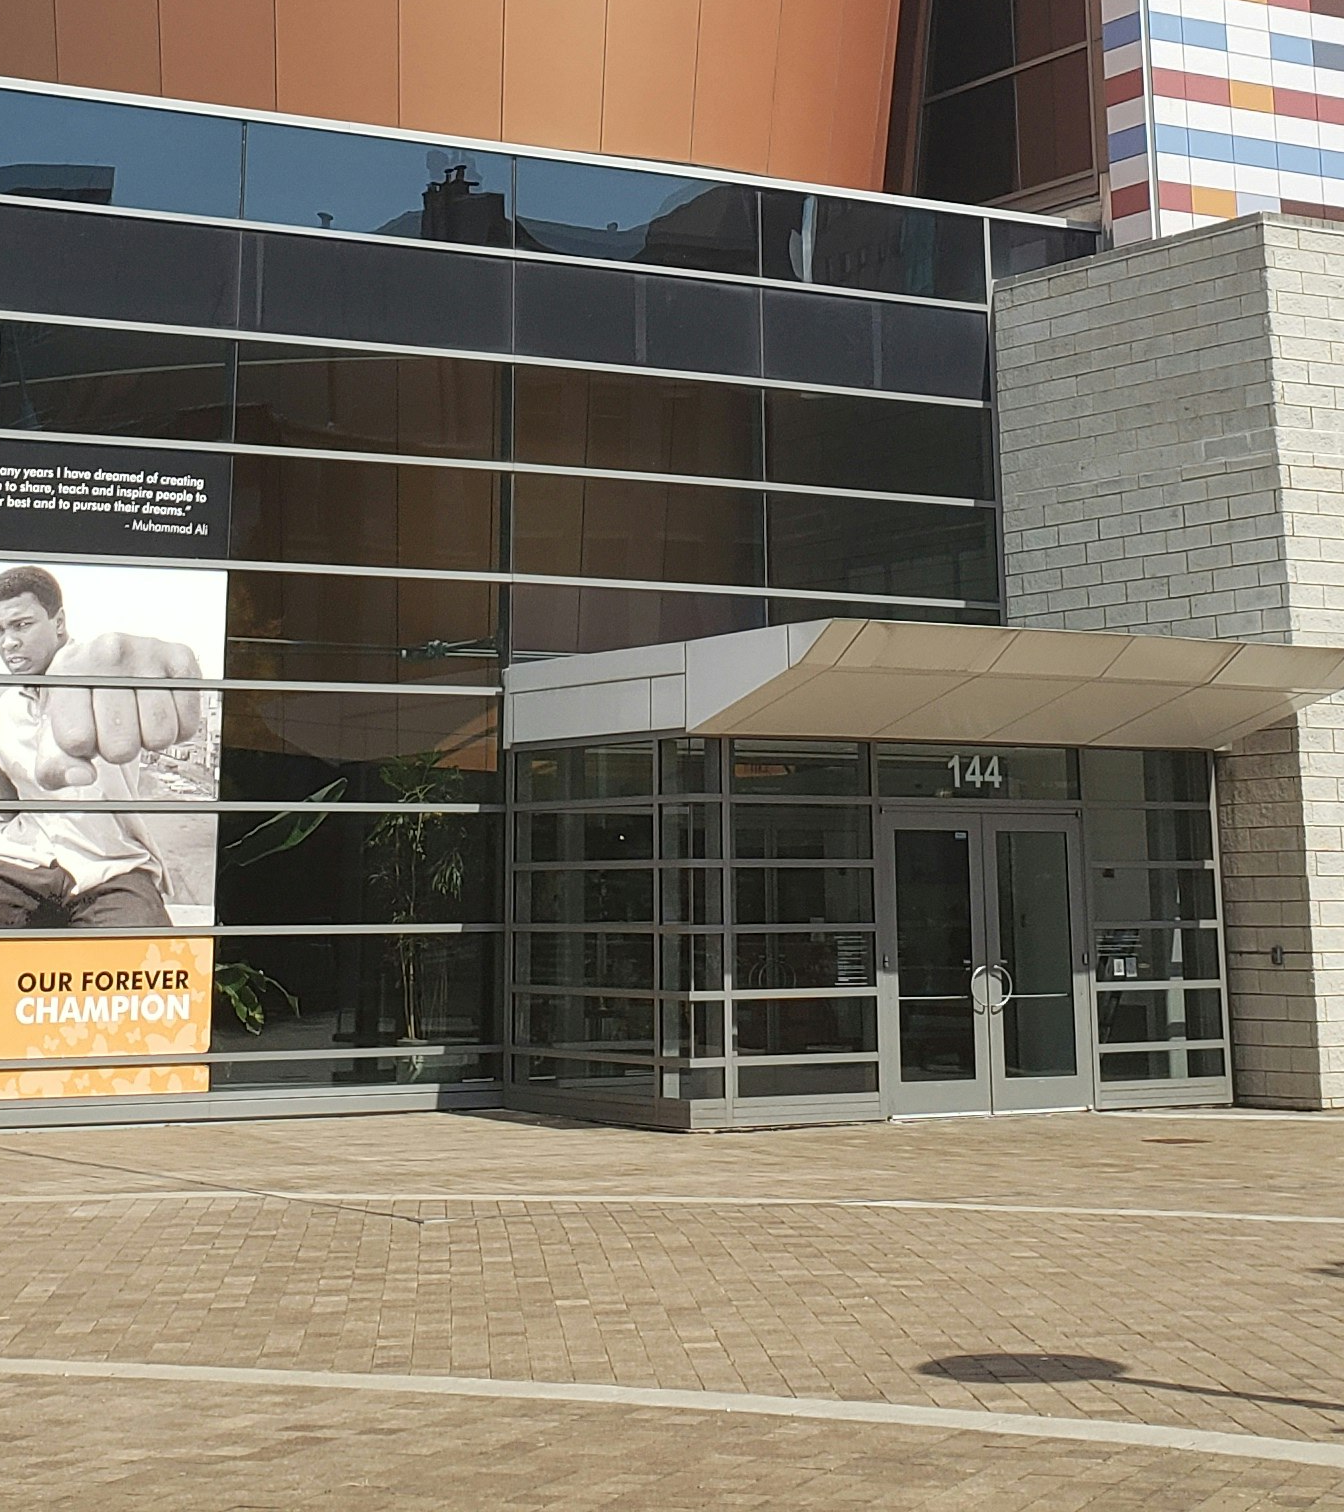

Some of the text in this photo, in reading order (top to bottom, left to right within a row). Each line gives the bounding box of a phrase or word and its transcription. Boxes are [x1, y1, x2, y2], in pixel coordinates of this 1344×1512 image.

[22, 468, 54, 480] years
[56, 467, 61, 478] I
[63, 467, 91, 480] have
[94, 468, 145, 483] dreamed
[146, 471, 159, 484] of
[160, 475, 205, 491] creating
[4, 481, 17, 492] to
[19, 480, 55, 495] share,
[58, 482, 89, 495] teach
[91, 484, 114, 497] and
[116, 485, 153, 500] inspire
[156, 489, 194, 504] people
[195, 491, 207, 503] to
[6, 495, 31, 508] best
[33, 496, 56, 509] and
[58, 498, 71, 510] to
[72, 500, 111, 513] pursue
[114, 500, 140, 513] their
[131, 519, 193, 535] Muhammad
[194, 523, 209, 536] Ali
[947, 754, 1003, 788] 144
[17, 970, 189, 993] OUR FOREVER
[15, 993, 190, 1025] CHAMPION
